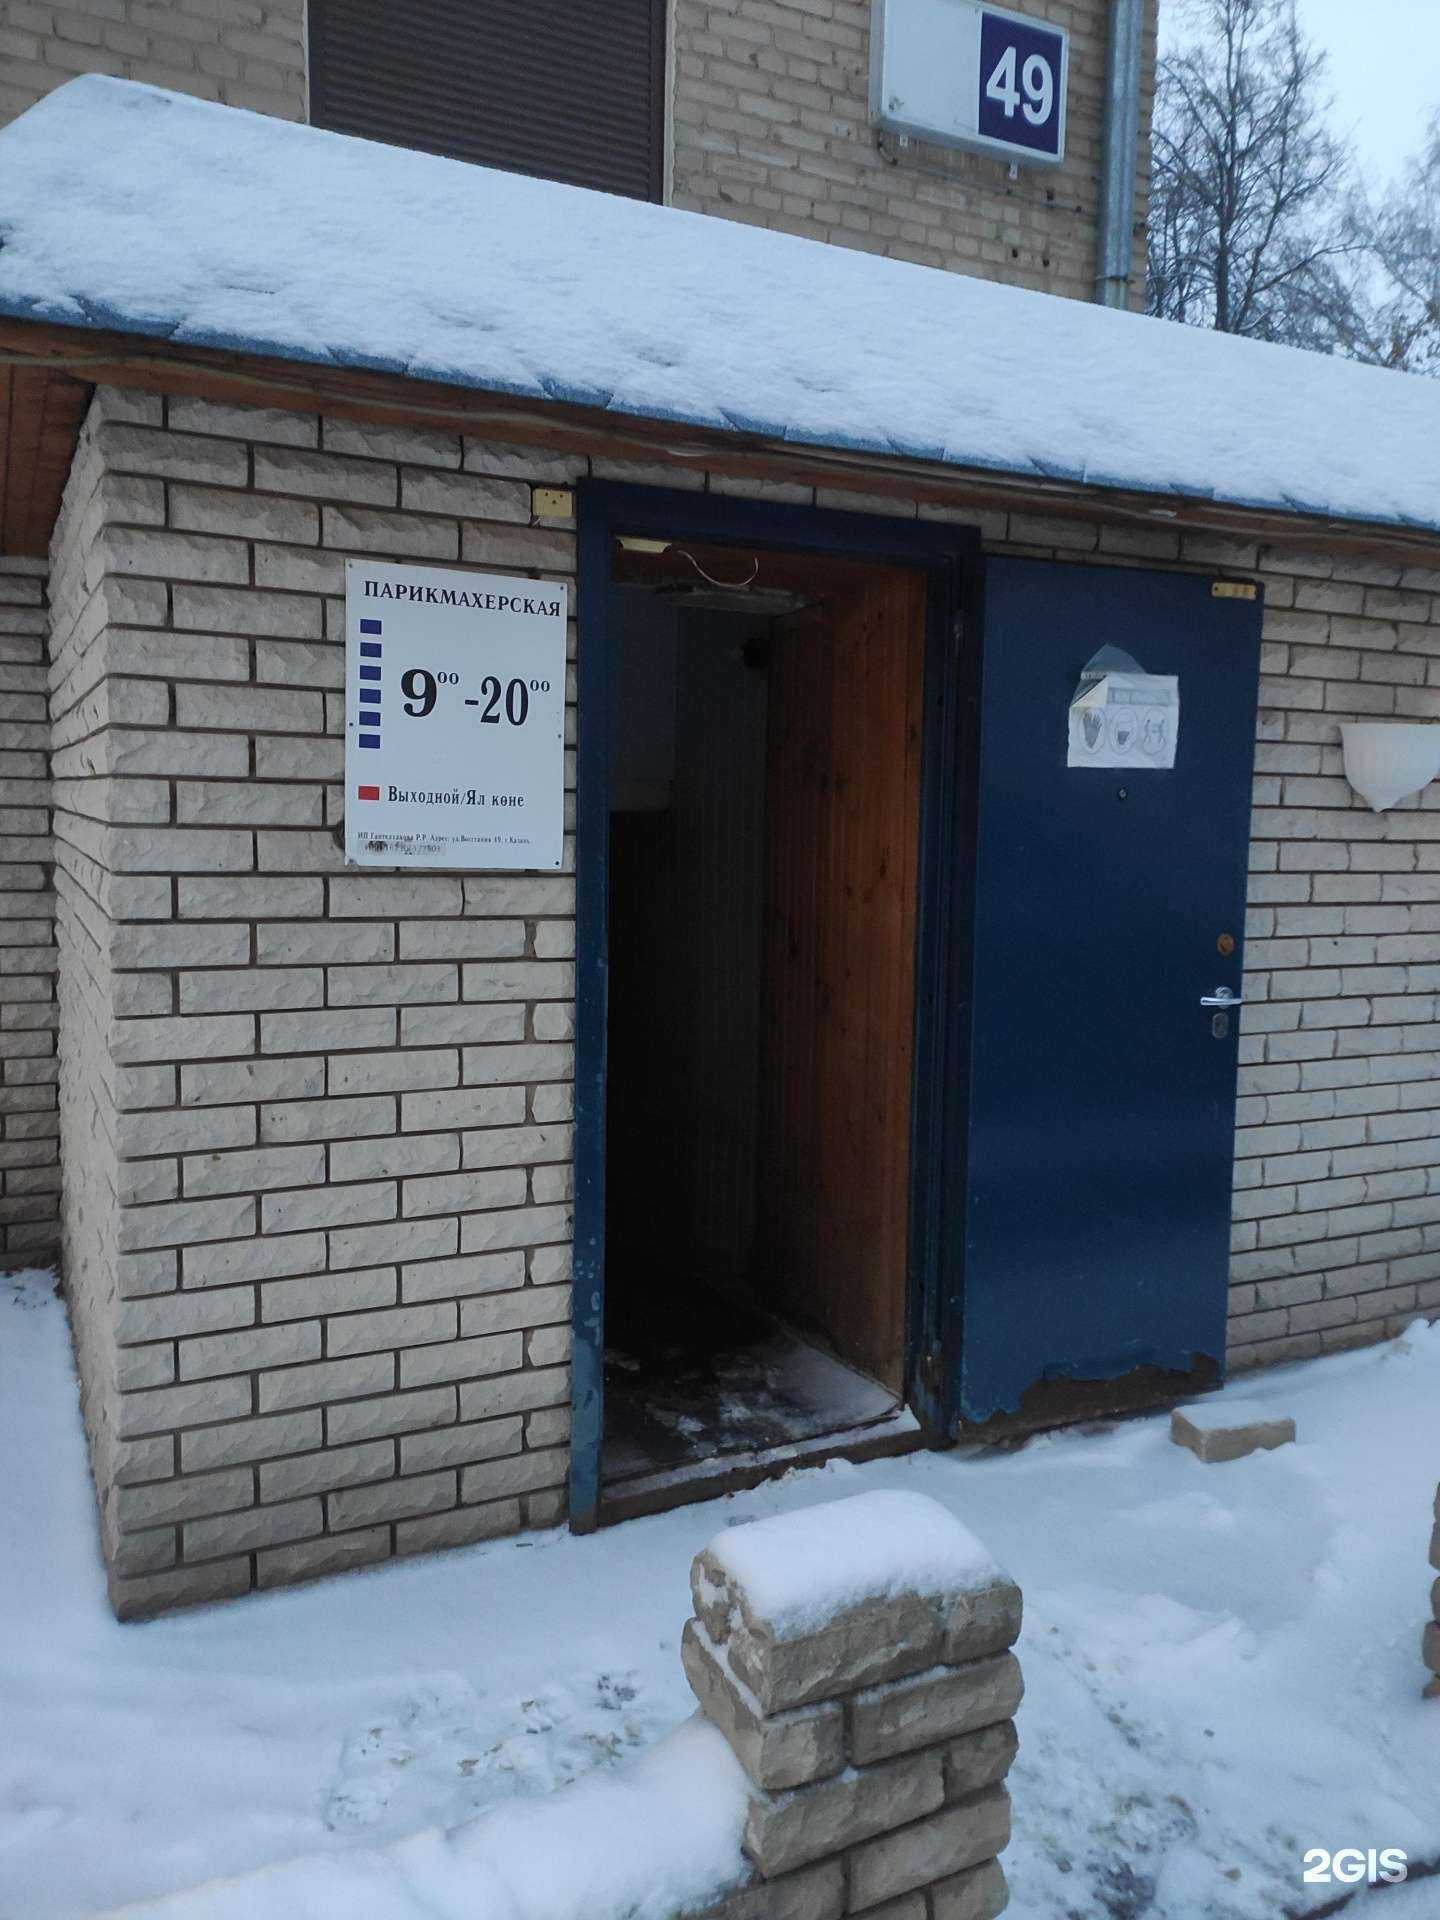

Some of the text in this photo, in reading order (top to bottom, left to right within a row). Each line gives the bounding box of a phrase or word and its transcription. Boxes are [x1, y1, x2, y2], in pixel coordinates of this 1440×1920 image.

[986, 46, 1053, 125] 49
[364, 580, 560, 617] ПАРИКМАХЕРСКАЯ
[492, 795, 524, 807] көне
